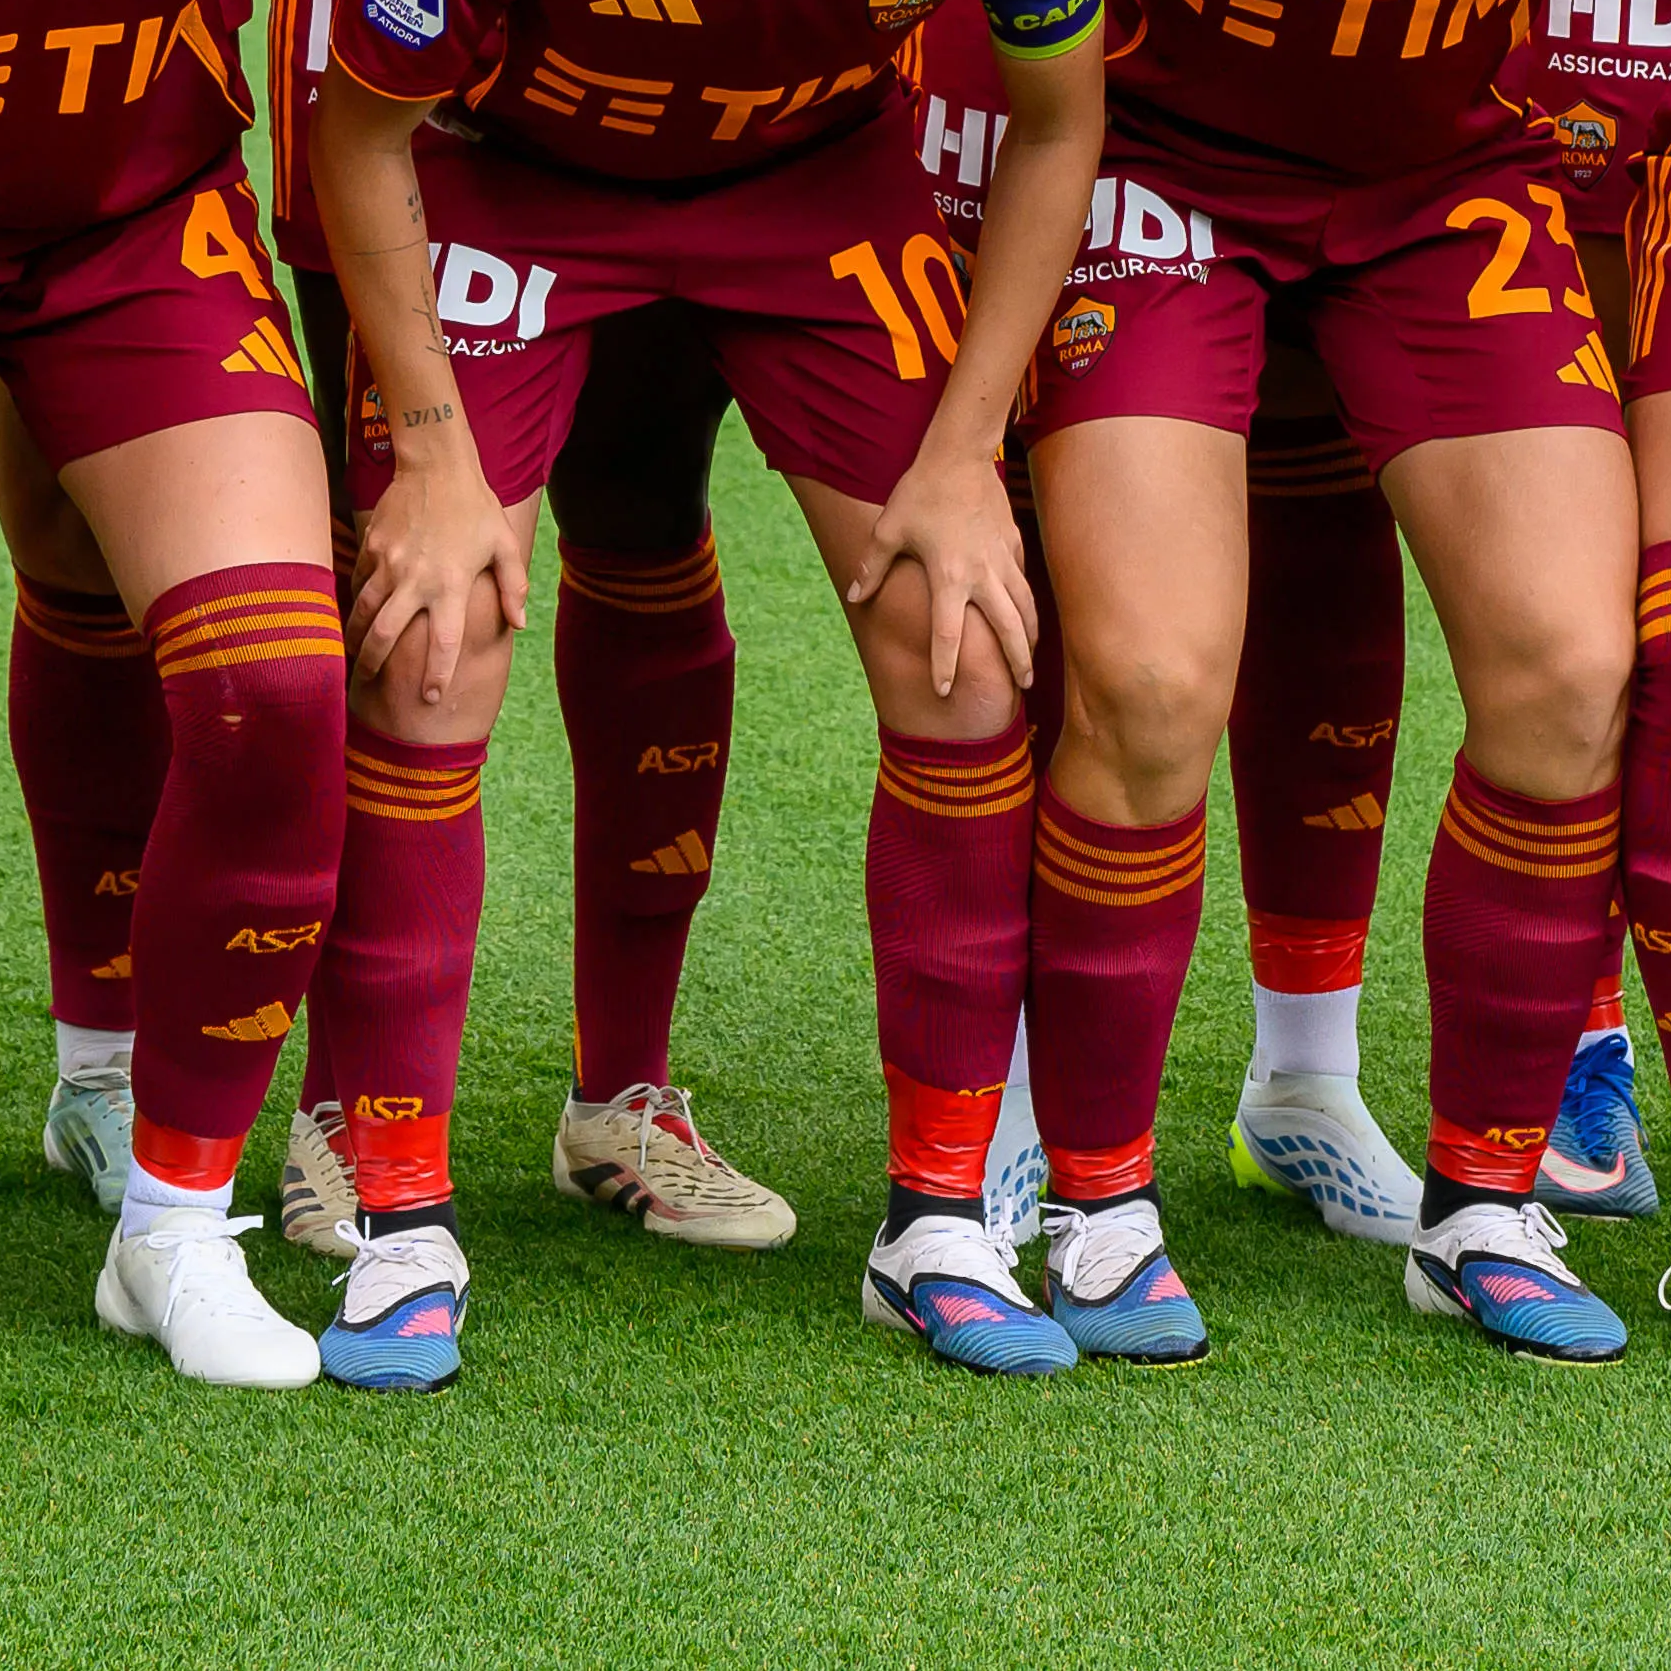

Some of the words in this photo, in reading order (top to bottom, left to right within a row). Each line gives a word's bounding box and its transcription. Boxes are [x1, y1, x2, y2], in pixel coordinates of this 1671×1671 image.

[377, 15, 421, 46] ATHORA
[1560, 151, 1607, 168] ROMA
[1573, 168, 1592, 179] 1927
[180, 189, 273, 300] 4
[428, 243, 557, 342] DI
[829, 233, 970, 380] 10
[1058, 337, 1105, 363] ROMA
[1070, 358, 1090, 371] 1927
[403, 402, 454, 428] 17/18
[364, 422, 389, 439] ROM
[373, 441, 390, 451] 1927
[637, 742, 719, 773] ASR
[95, 870, 142, 895] AS
